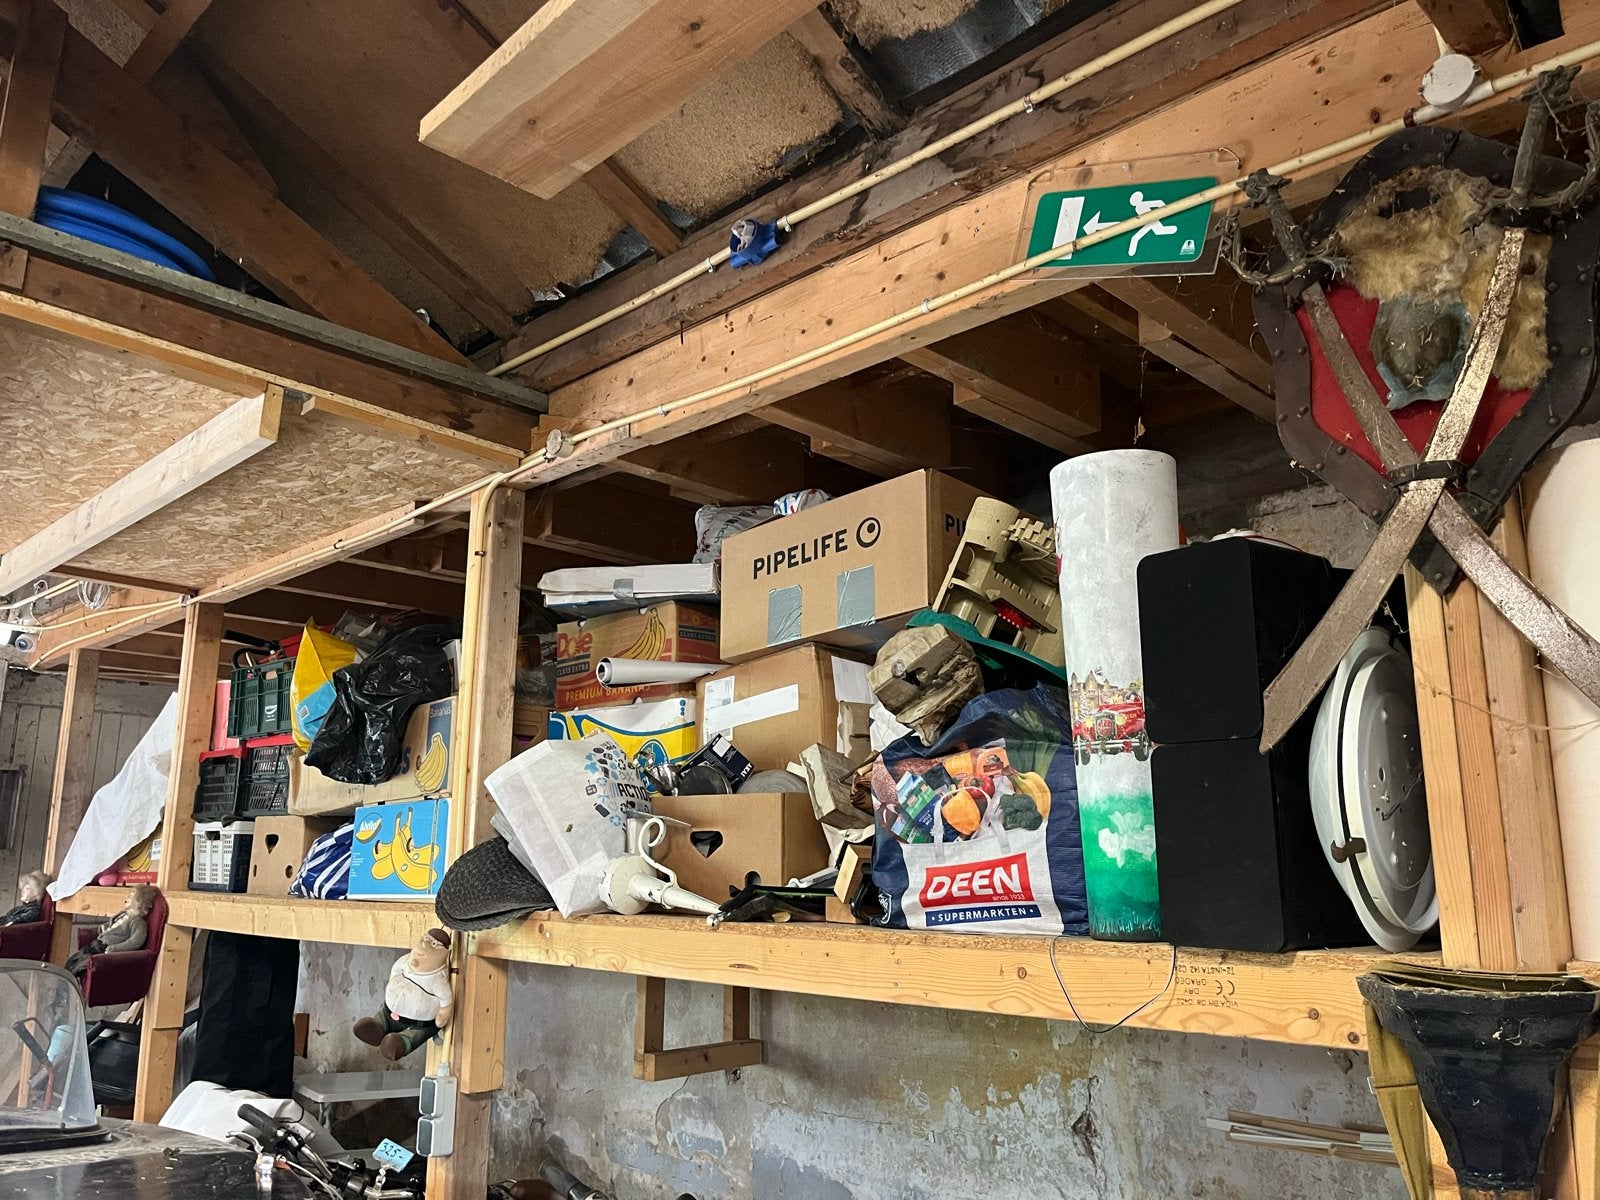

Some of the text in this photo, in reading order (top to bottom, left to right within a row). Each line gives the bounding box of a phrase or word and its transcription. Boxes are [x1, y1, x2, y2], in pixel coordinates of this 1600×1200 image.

[753, 528, 848, 580] PIPELIFE
[565, 685, 603, 704] PREMIUM
[926, 863, 1023, 900] DEEN
[938, 907, 1027, 922] SUPERMARKTEN
[1174, 976, 1207, 986] GRADED
[1183, 987, 1200, 995] DRY
